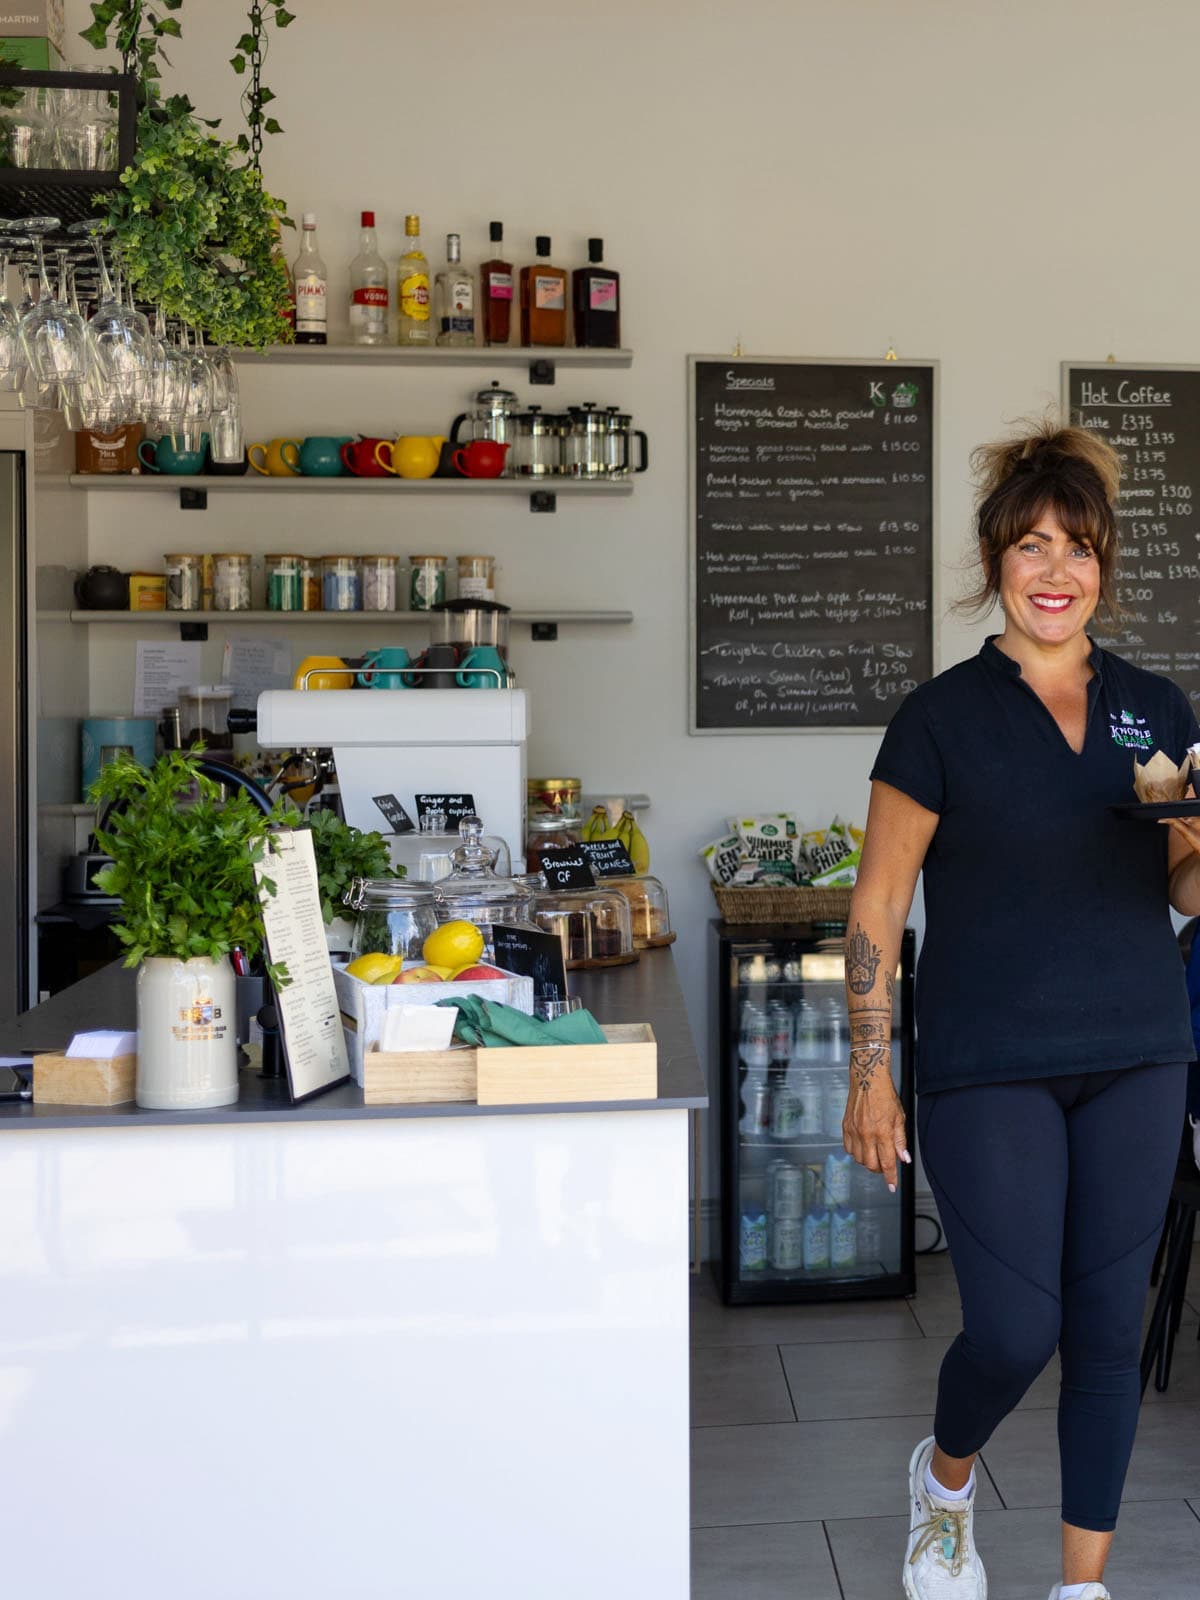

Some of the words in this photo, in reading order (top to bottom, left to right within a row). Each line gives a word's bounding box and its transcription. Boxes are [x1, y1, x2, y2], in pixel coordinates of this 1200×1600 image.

[726, 371, 776, 389] Specials
[1081, 382, 1109, 405] Hot
[1117, 381, 1172, 405] Coffee
[714, 403, 774, 418] Homemade
[1079, 411, 1111, 429] Latte
[710, 592, 769, 607] Homemade
[801, 590, 824, 604] and
[1121, 630, 1144, 645] Tea
[709, 642, 768, 664] Teriyaki
[771, 642, 826, 659] Chicken
[713, 673, 762, 689] Teriyaki
[420, 796, 445, 808] Ginger
[448, 797, 463, 805] and
[590, 851, 617, 860] FRUIT
